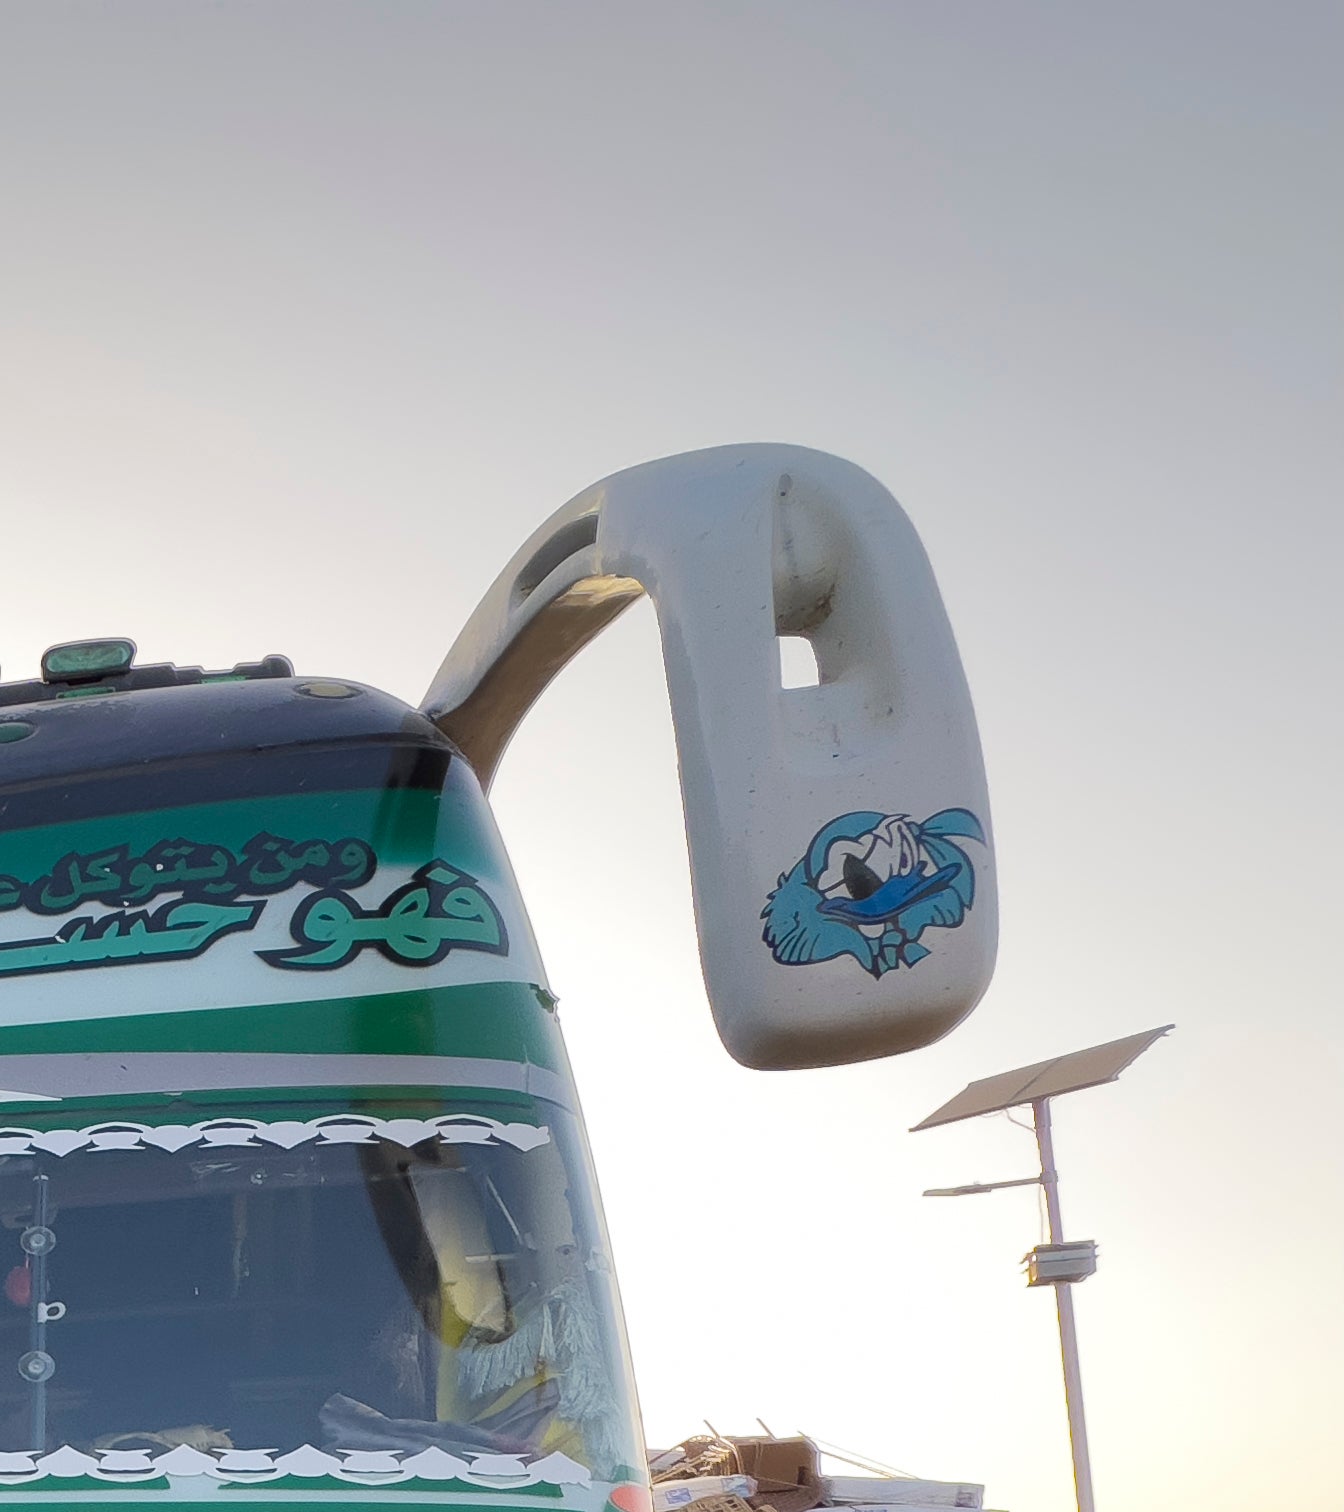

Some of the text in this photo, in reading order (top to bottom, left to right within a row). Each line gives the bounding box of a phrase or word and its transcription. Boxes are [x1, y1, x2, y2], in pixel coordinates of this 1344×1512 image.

[34, 838, 234, 910] يتوكل
[242, 834, 374, 892] ومن
[256, 858, 509, 968] فهو
